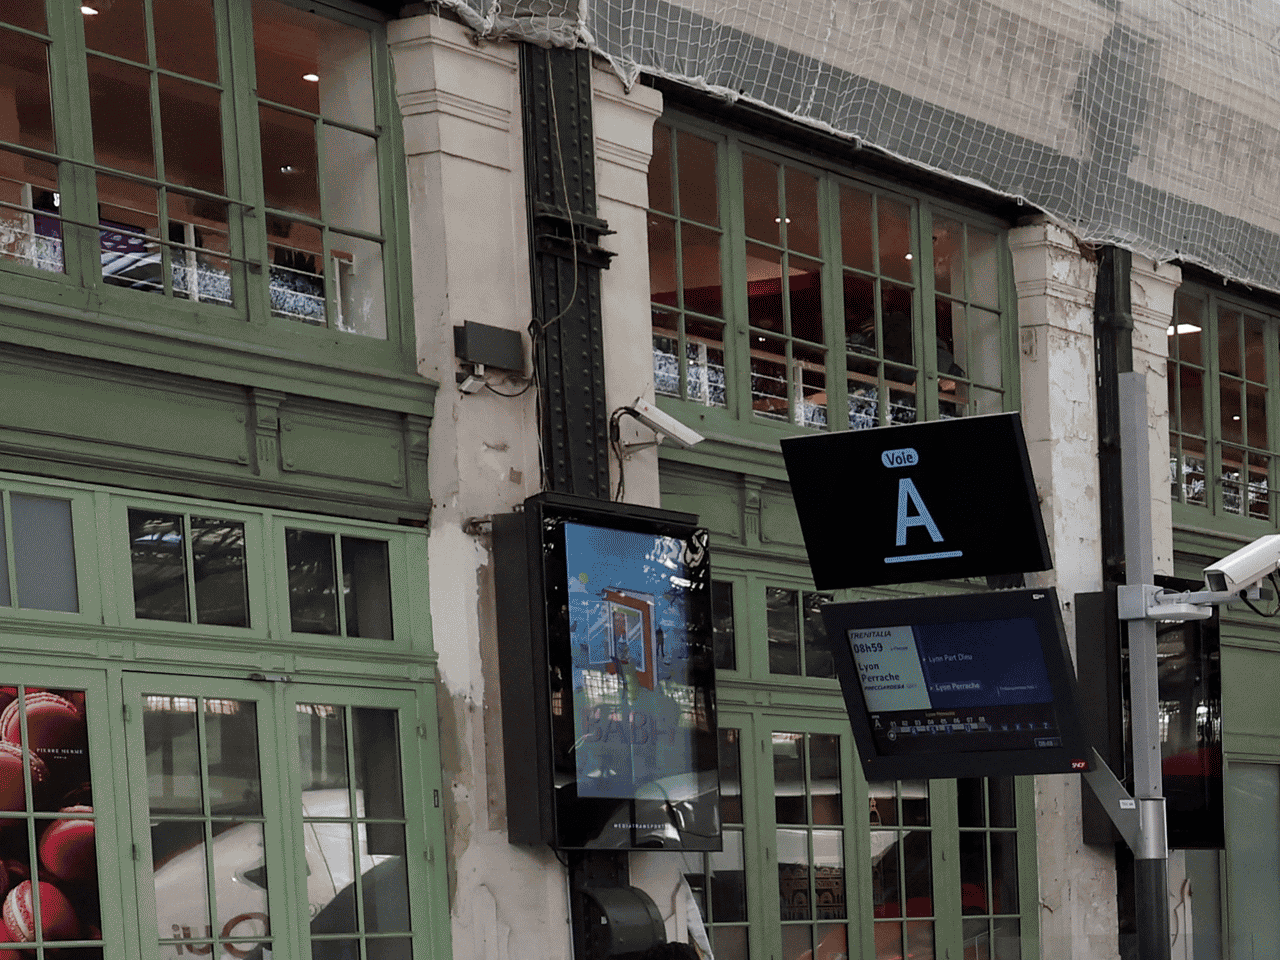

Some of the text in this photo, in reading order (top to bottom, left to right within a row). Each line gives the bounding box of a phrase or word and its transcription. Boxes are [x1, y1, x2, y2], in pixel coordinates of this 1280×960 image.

[886, 450, 914, 467] Voie
[895, 477, 944, 546] A
[849, 631, 892, 639] TRENITALIA
[853, 643, 883, 654] 08h59
[928, 655, 945, 664] Lyon
[858, 662, 880, 672] Lyon
[861, 672, 899, 682] Perrache
[935, 682, 981, 691] Lyon Perrache
